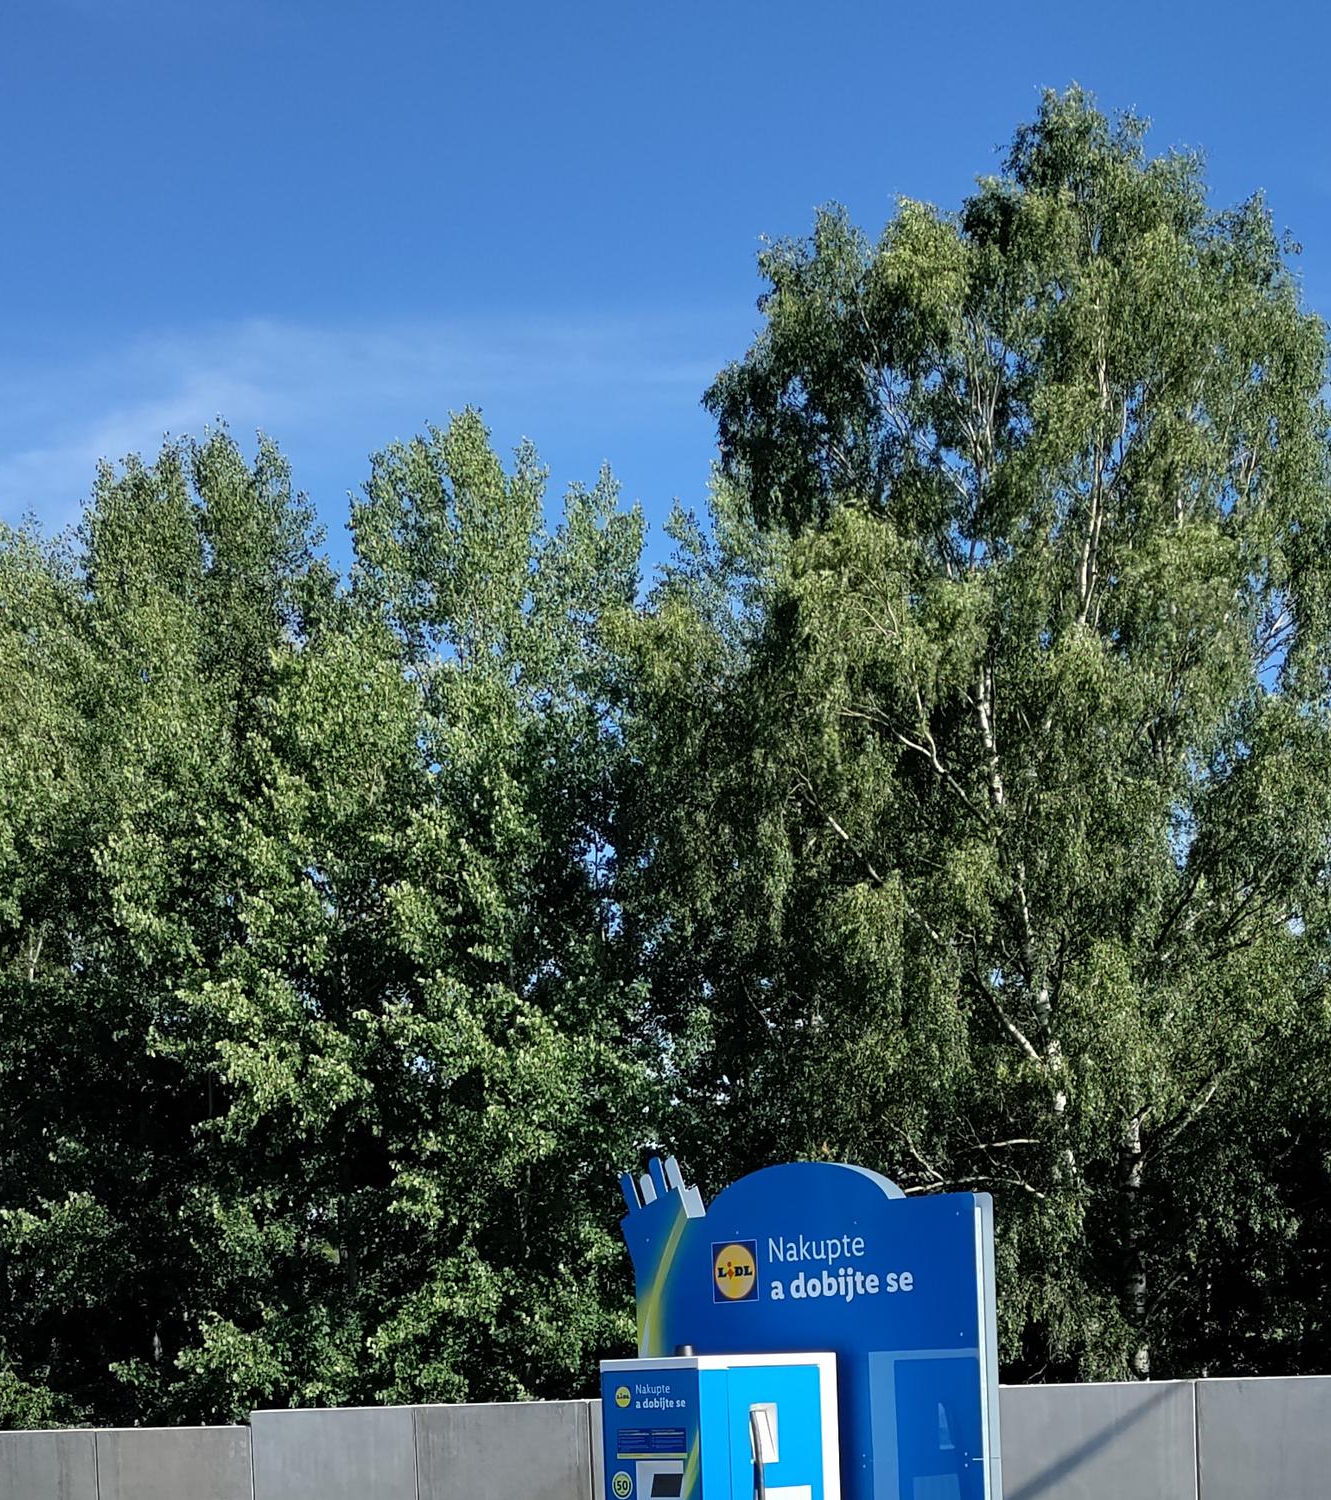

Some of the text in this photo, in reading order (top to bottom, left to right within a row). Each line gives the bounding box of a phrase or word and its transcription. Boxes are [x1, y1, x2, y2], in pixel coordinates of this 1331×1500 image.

[768, 1235, 865, 1265] Nakupte
[771, 1267, 914, 1302] a dobijte se
[635, 1384, 670, 1396] Nakupte
[635, 1397, 686, 1410] a dobijte se
[616, 1480, 628, 1492] 50
